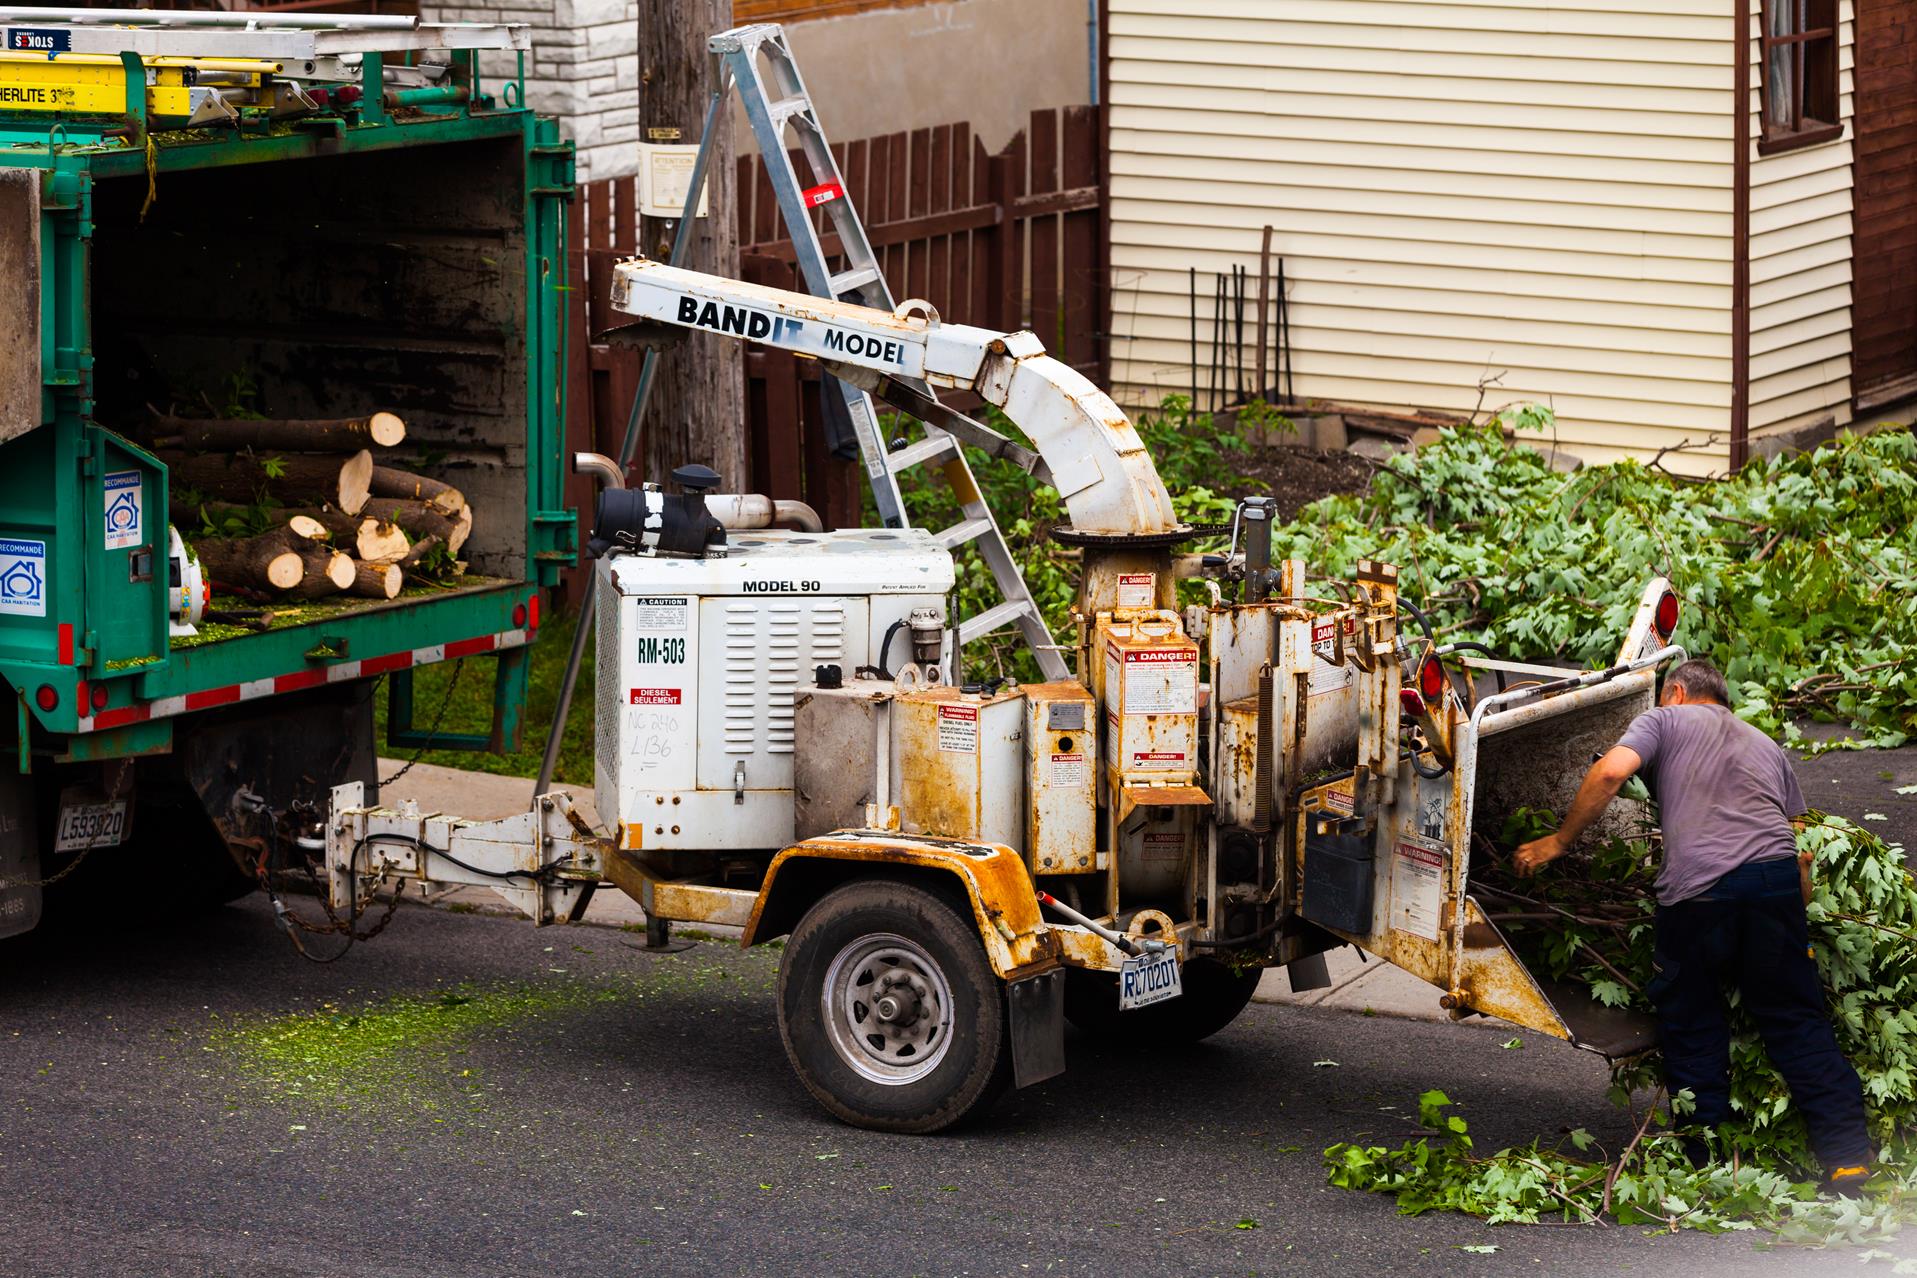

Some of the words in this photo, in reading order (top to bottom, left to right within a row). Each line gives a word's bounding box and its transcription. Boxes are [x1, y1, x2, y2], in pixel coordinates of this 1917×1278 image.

[15, 35, 54, 48] STOKES
[677, 296, 804, 342] BANDIT
[824, 328, 904, 365] MODEL
[743, 581, 797, 592] MODEL
[801, 581, 821, 592] 90
[638, 638, 685, 664] RM-503
[1140, 652, 1195, 661] DANGER!
[634, 696, 678, 704] SEULEMENT
[1403, 846, 1442, 865] WARNING!
[1124, 958, 1177, 997] RC7020T
